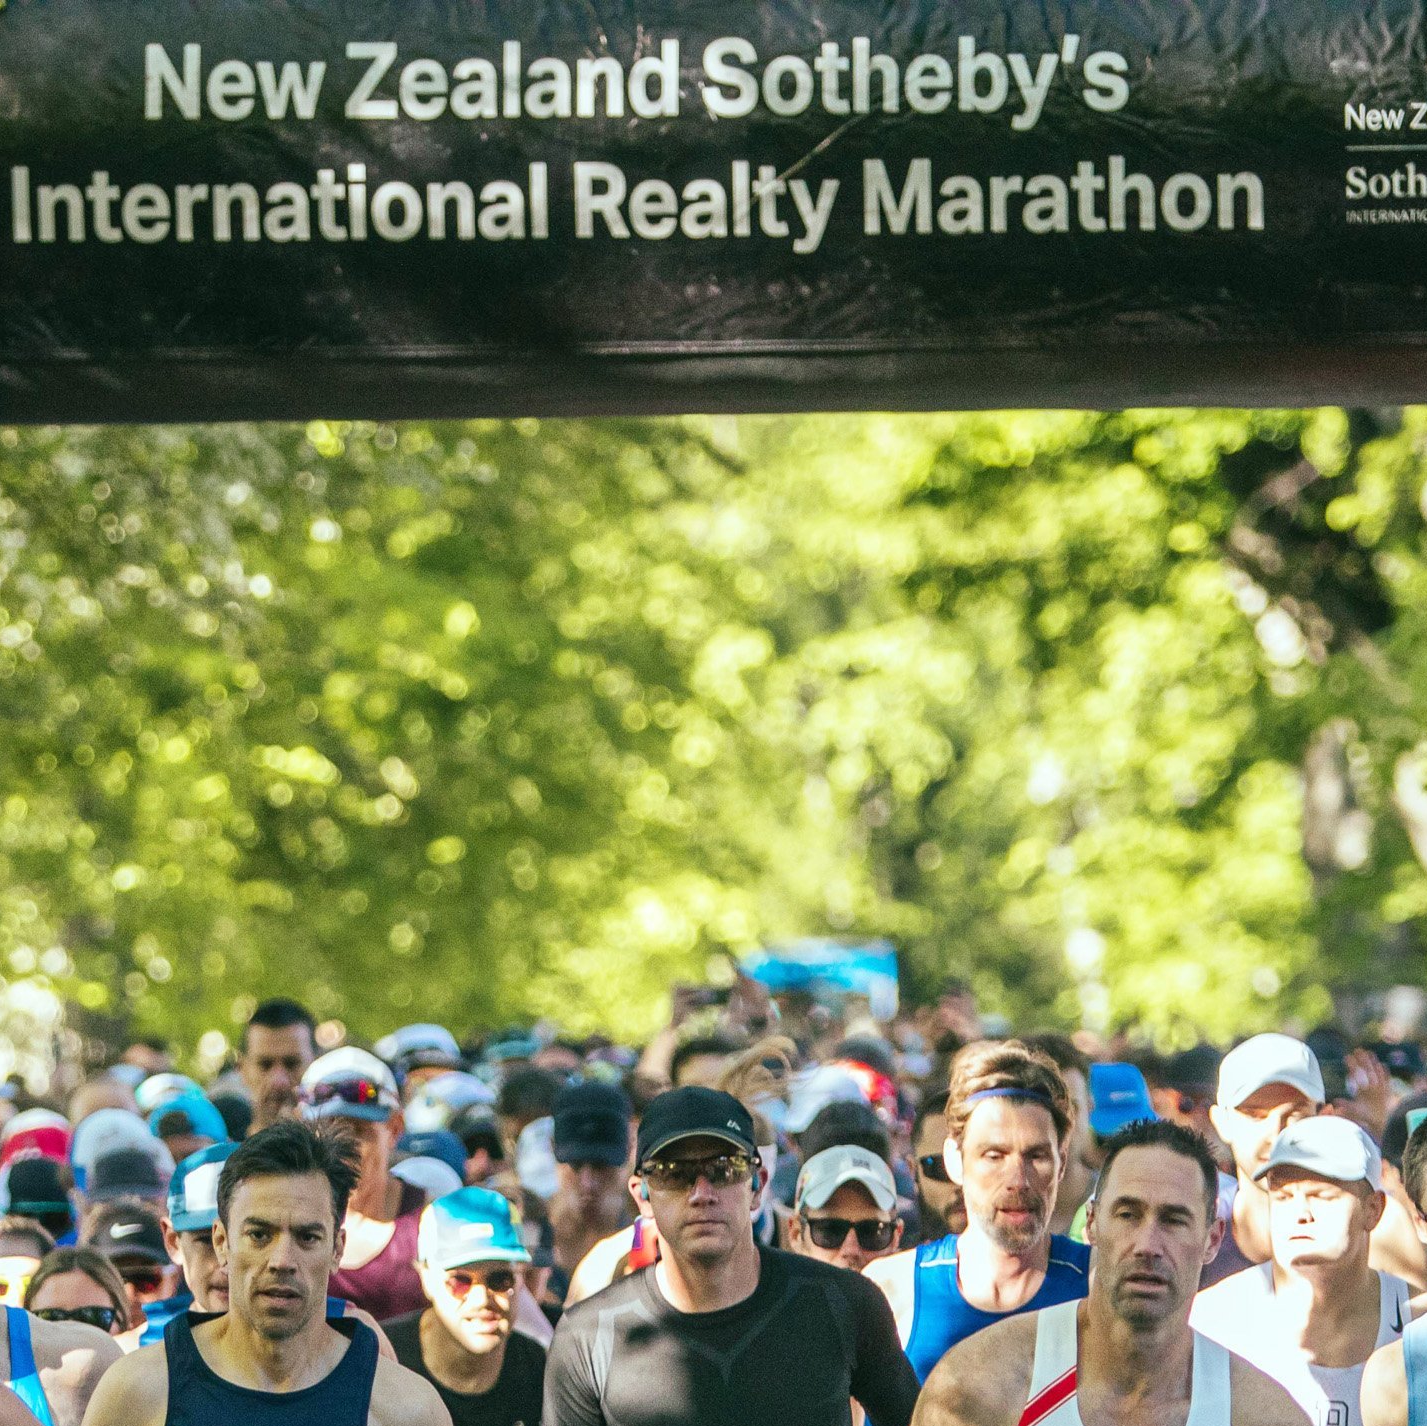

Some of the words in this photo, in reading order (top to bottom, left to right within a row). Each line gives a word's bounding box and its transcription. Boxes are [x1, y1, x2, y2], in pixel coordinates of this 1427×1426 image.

[144, 42, 326, 120] New
[345, 39, 681, 120] Zealand
[702, 34, 1130, 130] Sotheby's
[1344, 102, 1405, 132] New
[11, 161, 548, 244] International
[574, 160, 838, 254] Realty
[863, 156, 1265, 235] Marathon
